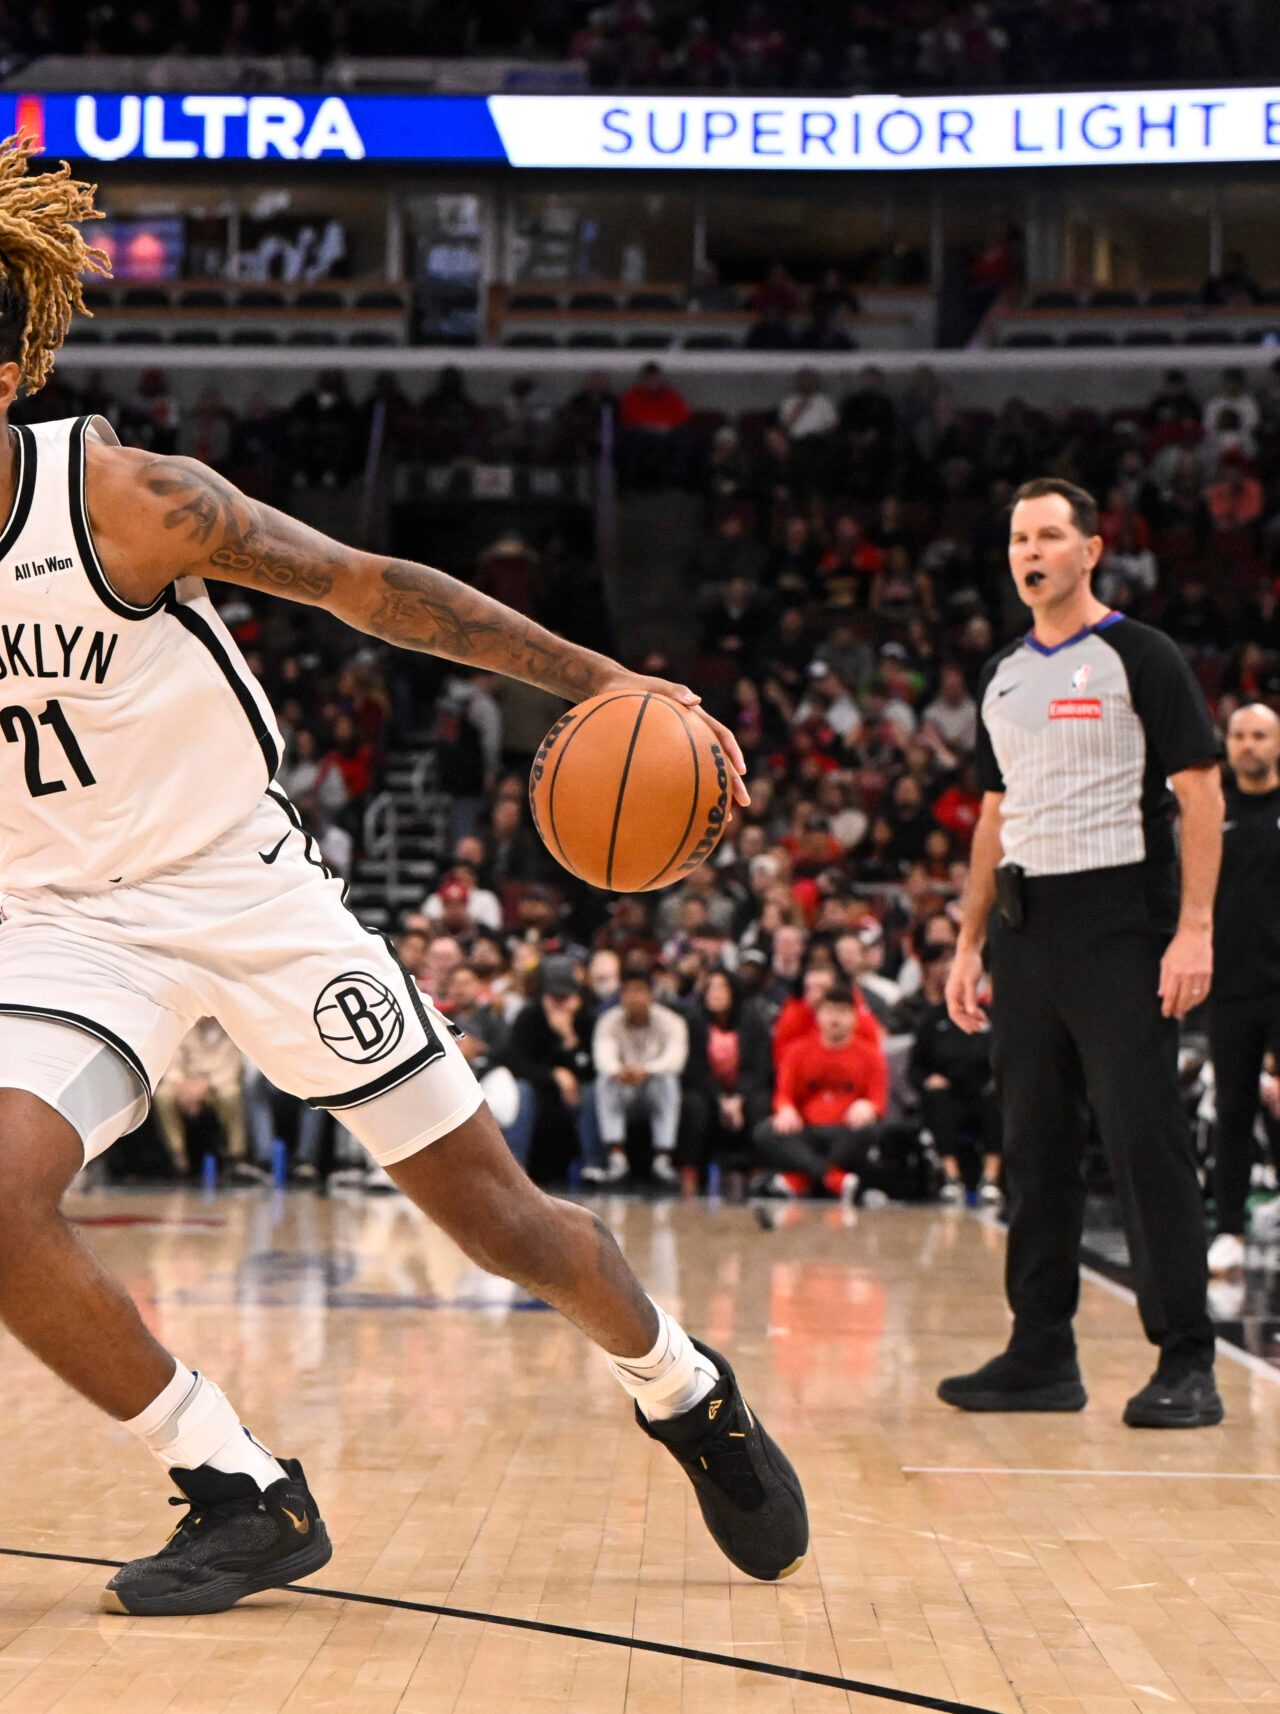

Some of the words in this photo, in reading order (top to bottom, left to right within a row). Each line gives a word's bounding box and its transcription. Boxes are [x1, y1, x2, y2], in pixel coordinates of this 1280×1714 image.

[74, 95, 366, 159] ULTRA
[601, 108, 975, 155] SUPERIOR
[1014, 102, 1225, 152] LIGHT
[15, 563, 32, 581] All
[32, 561, 46, 576] In
[45, 556, 74, 573] Won
[0, 699, 97, 798] 21
[334, 986, 384, 1051] B
